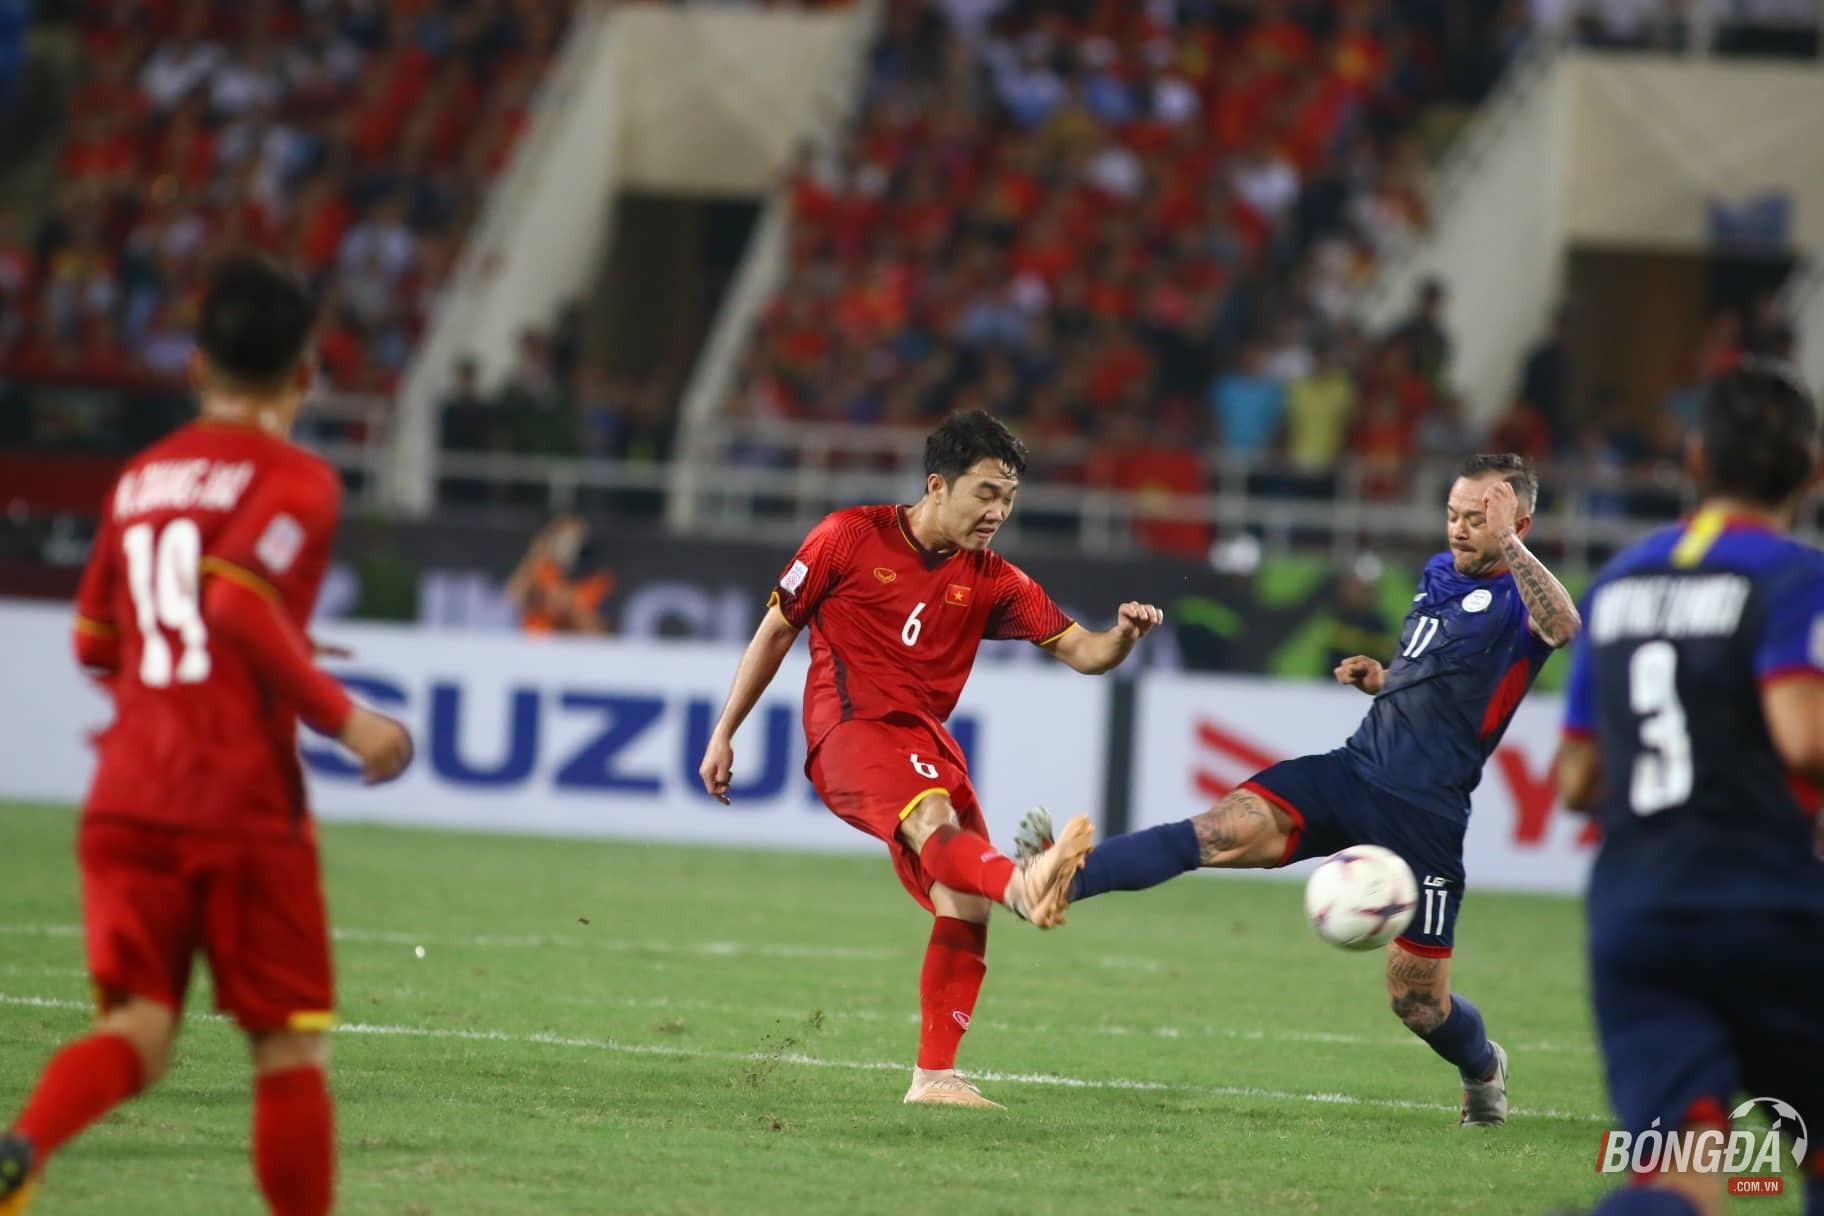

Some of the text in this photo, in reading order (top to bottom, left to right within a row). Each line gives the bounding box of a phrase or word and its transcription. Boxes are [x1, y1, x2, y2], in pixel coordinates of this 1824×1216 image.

[123, 517, 212, 689] 19
[901, 602, 927, 647] 6
[1402, 615, 1439, 658] 11
[298, 670, 983, 805] UZUI
[1629, 640, 1694, 816] 3
[910, 753, 939, 778] 6
[1423, 888, 1448, 935] 11
